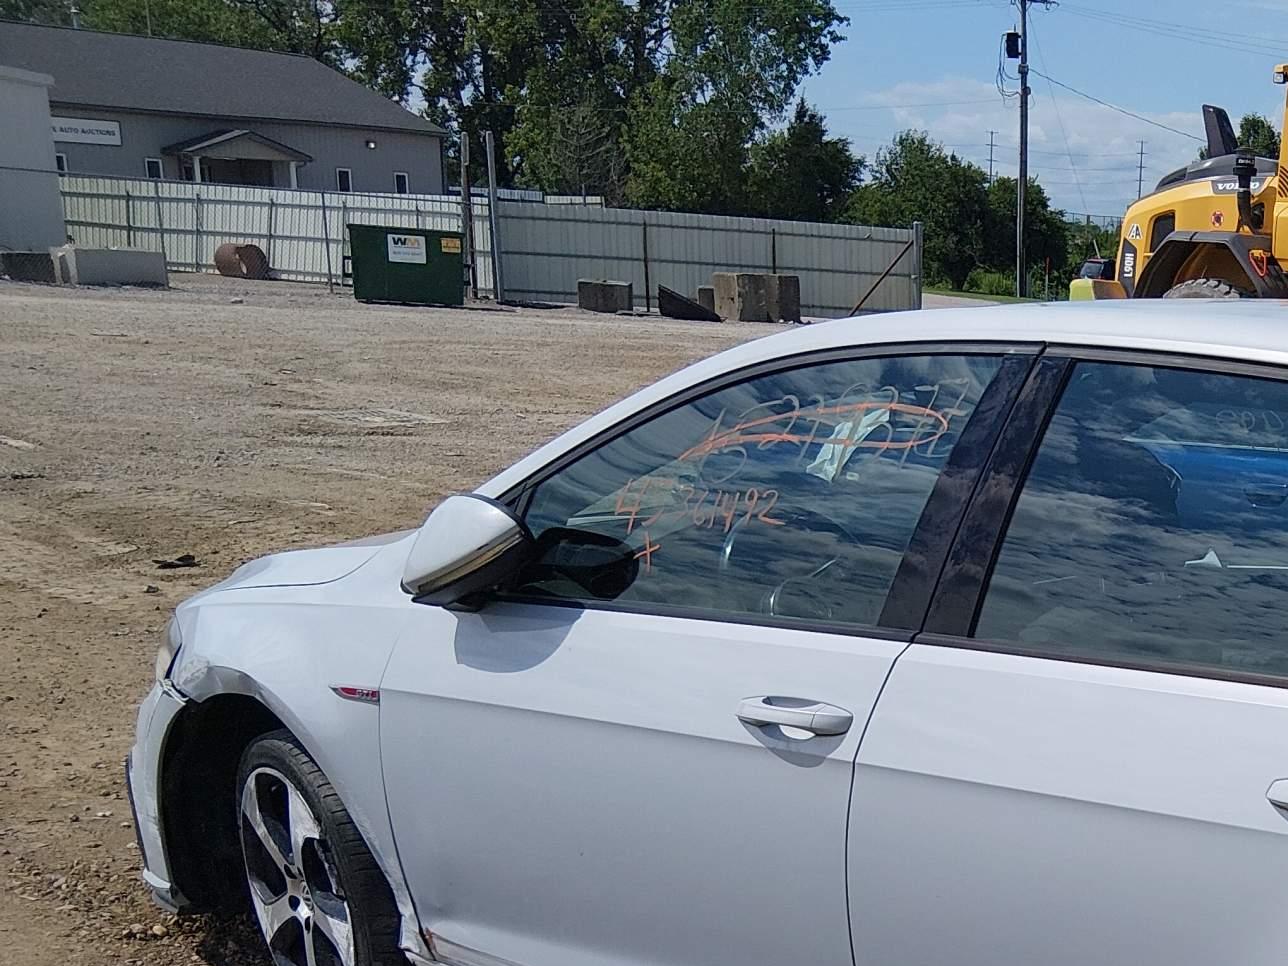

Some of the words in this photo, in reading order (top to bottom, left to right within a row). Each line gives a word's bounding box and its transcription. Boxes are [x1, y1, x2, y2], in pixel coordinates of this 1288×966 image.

[81, 128, 116, 137] AUCTIONS
[1217, 182, 1260, 190] VOLO
[1124, 253, 1135, 277] L90H
